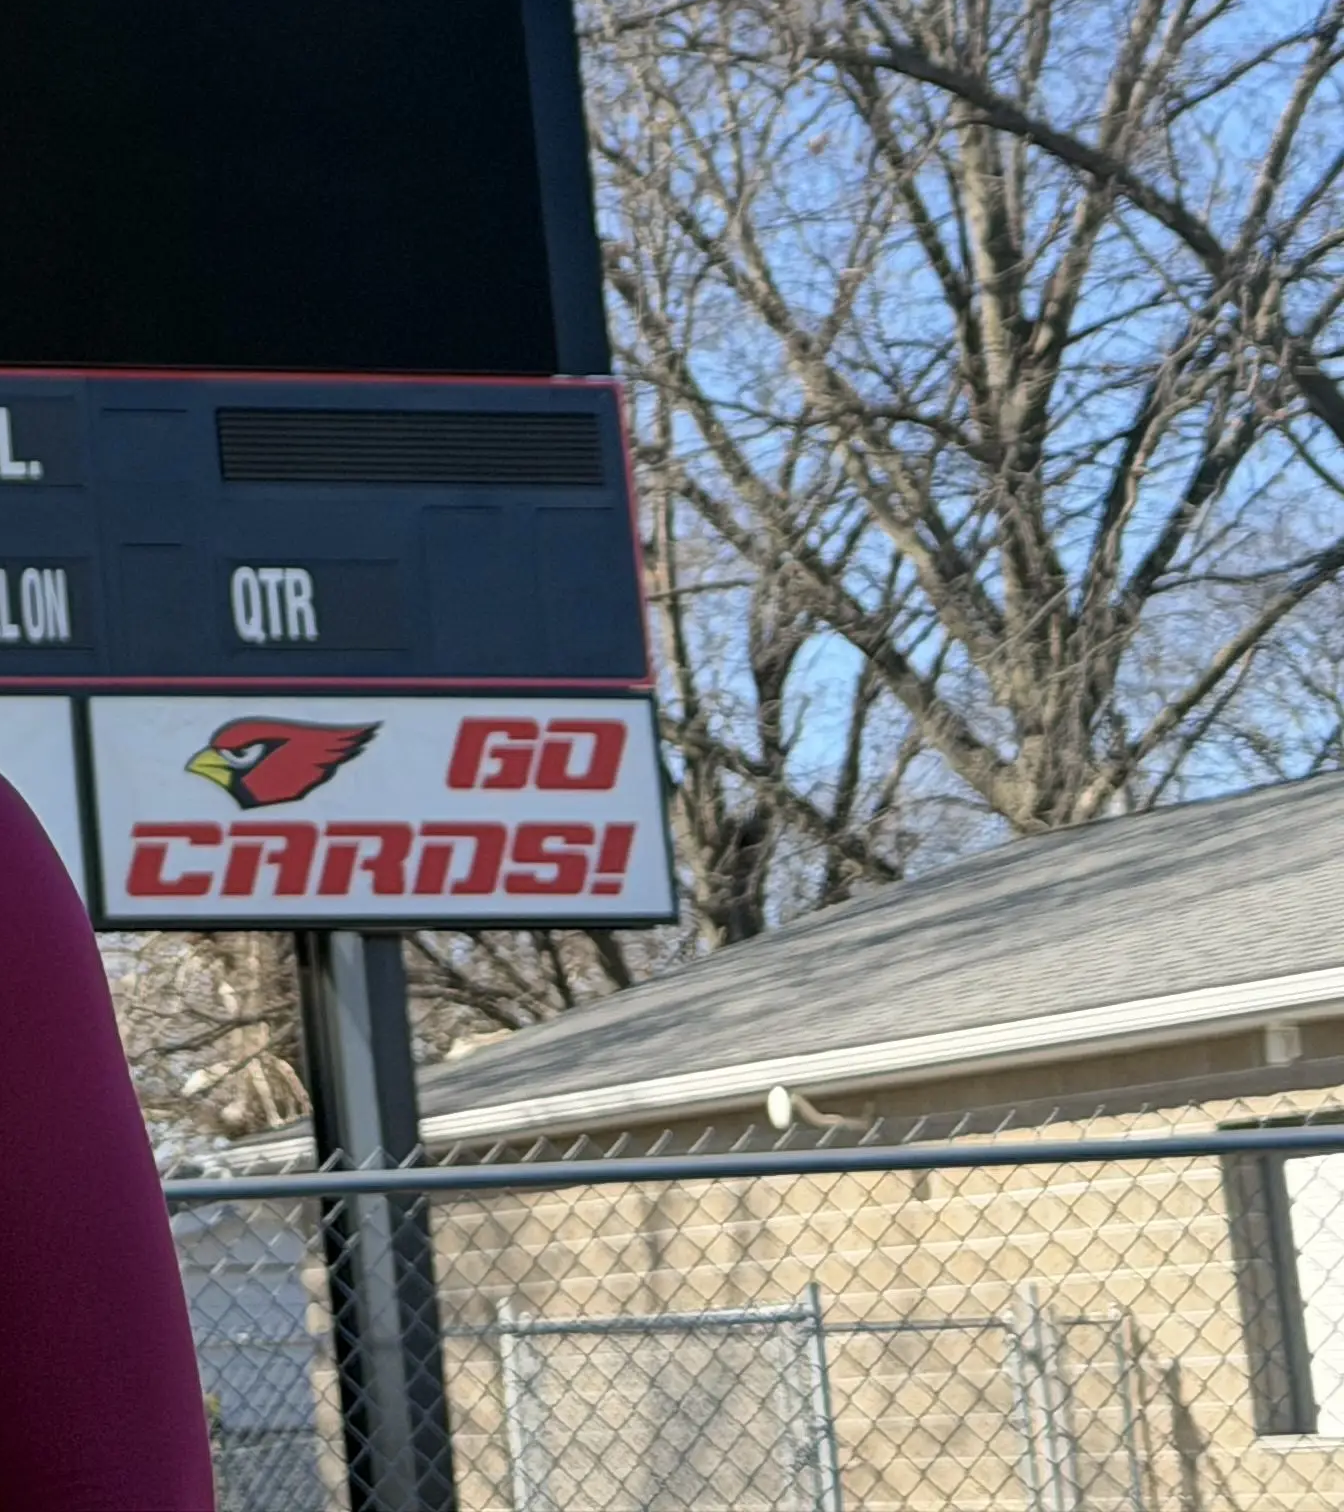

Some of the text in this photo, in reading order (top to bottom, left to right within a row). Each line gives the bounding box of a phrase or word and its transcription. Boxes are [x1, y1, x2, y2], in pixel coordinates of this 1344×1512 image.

[20, 566, 71, 642] ON
[229, 564, 319, 644] QTR
[444, 716, 628, 791] GO
[125, 821, 638, 897] CARDS!
